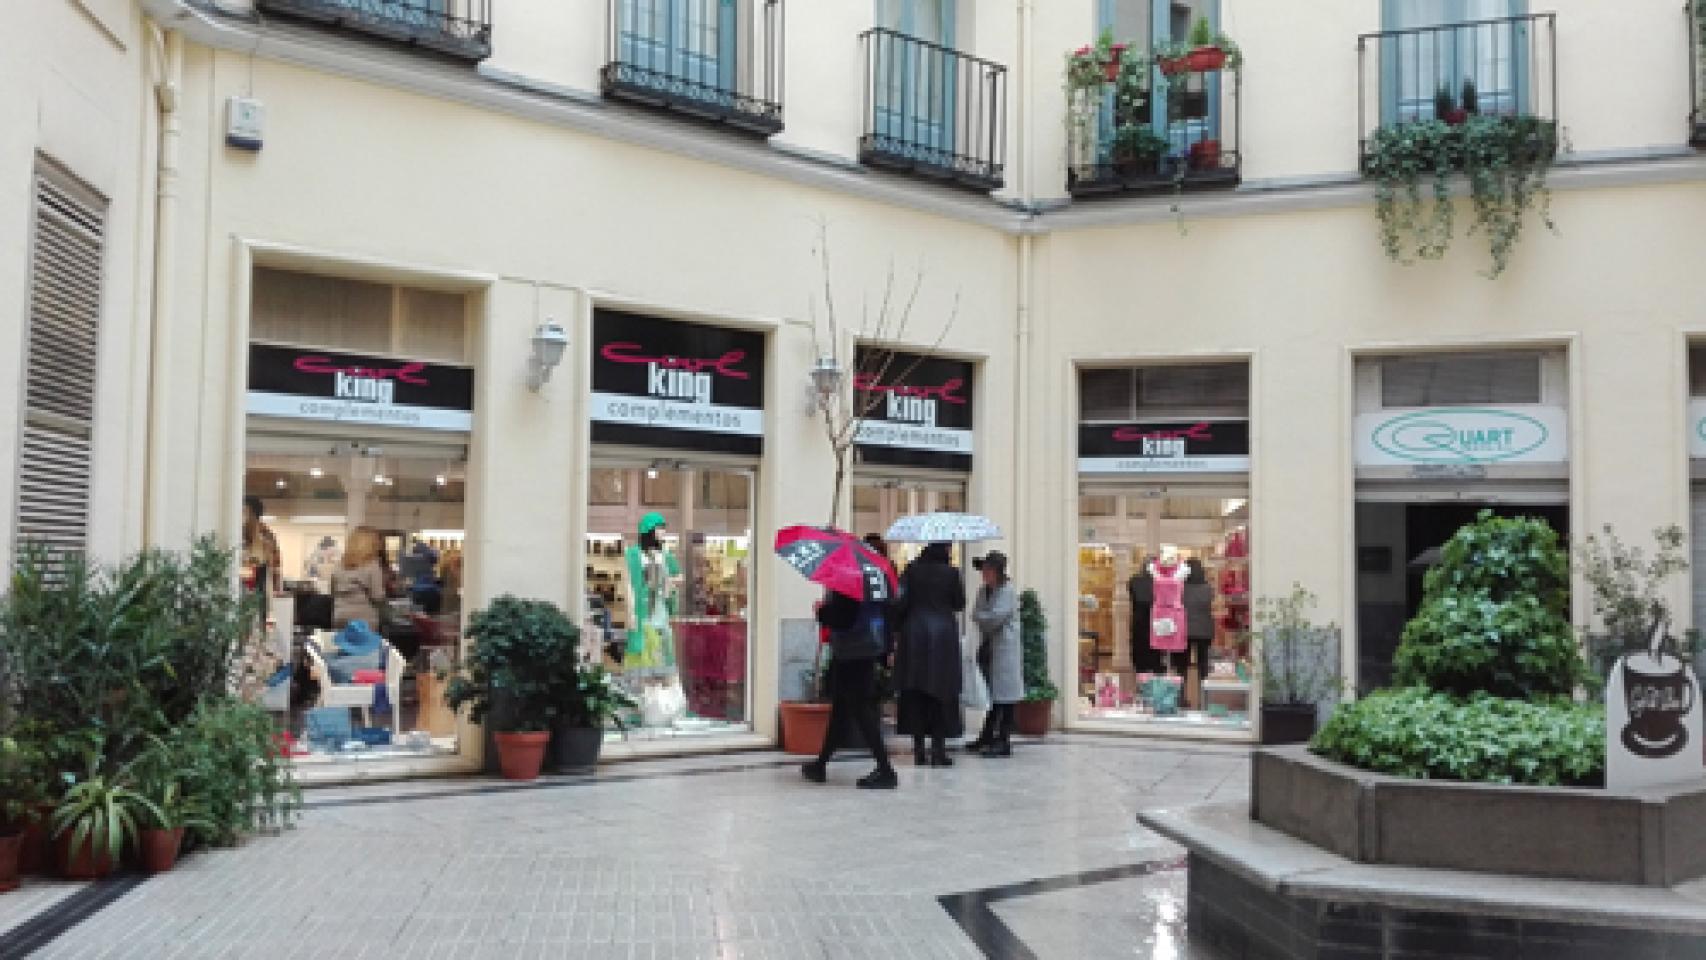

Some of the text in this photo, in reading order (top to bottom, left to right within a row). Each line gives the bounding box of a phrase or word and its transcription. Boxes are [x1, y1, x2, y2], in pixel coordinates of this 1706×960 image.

[337, 367, 393, 404] king
[648, 356, 711, 404] king
[300, 401, 420, 421] complementos
[607, 402, 741, 427] complementos
[887, 383, 936, 427] king
